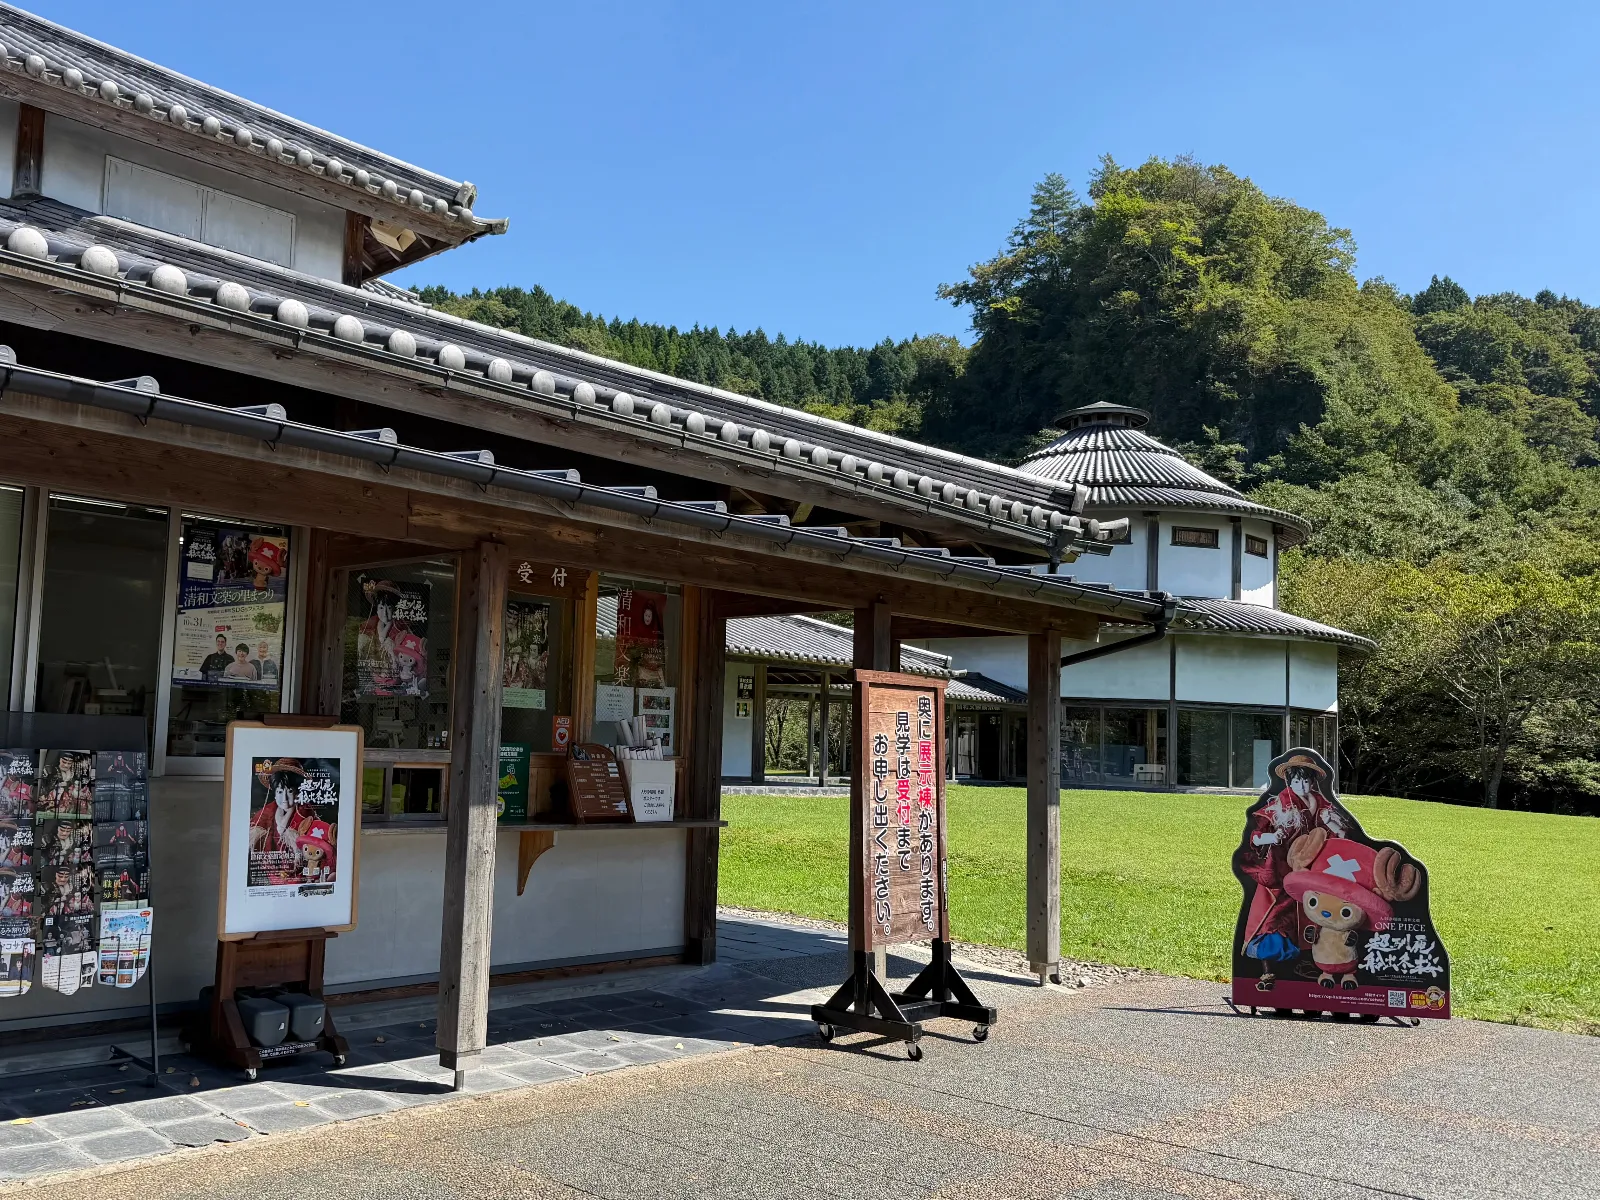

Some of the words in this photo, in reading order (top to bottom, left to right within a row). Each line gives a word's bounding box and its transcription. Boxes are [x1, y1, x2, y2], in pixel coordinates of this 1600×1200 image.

[183, 588, 274, 608] 清和文楽の里まつり
[516, 561, 568, 588] 受付
[613, 587, 633, 687] 清和文楽
[556, 717, 570, 725] AED
[895, 711, 911, 872] 見学は受付まで
[917, 695, 934, 932] 奥に展示棟があります。
[872, 732, 892, 936] お申し出ください。
[1374, 921, 1399, 932] ONE
[1399, 923, 1426, 933] PIECE
